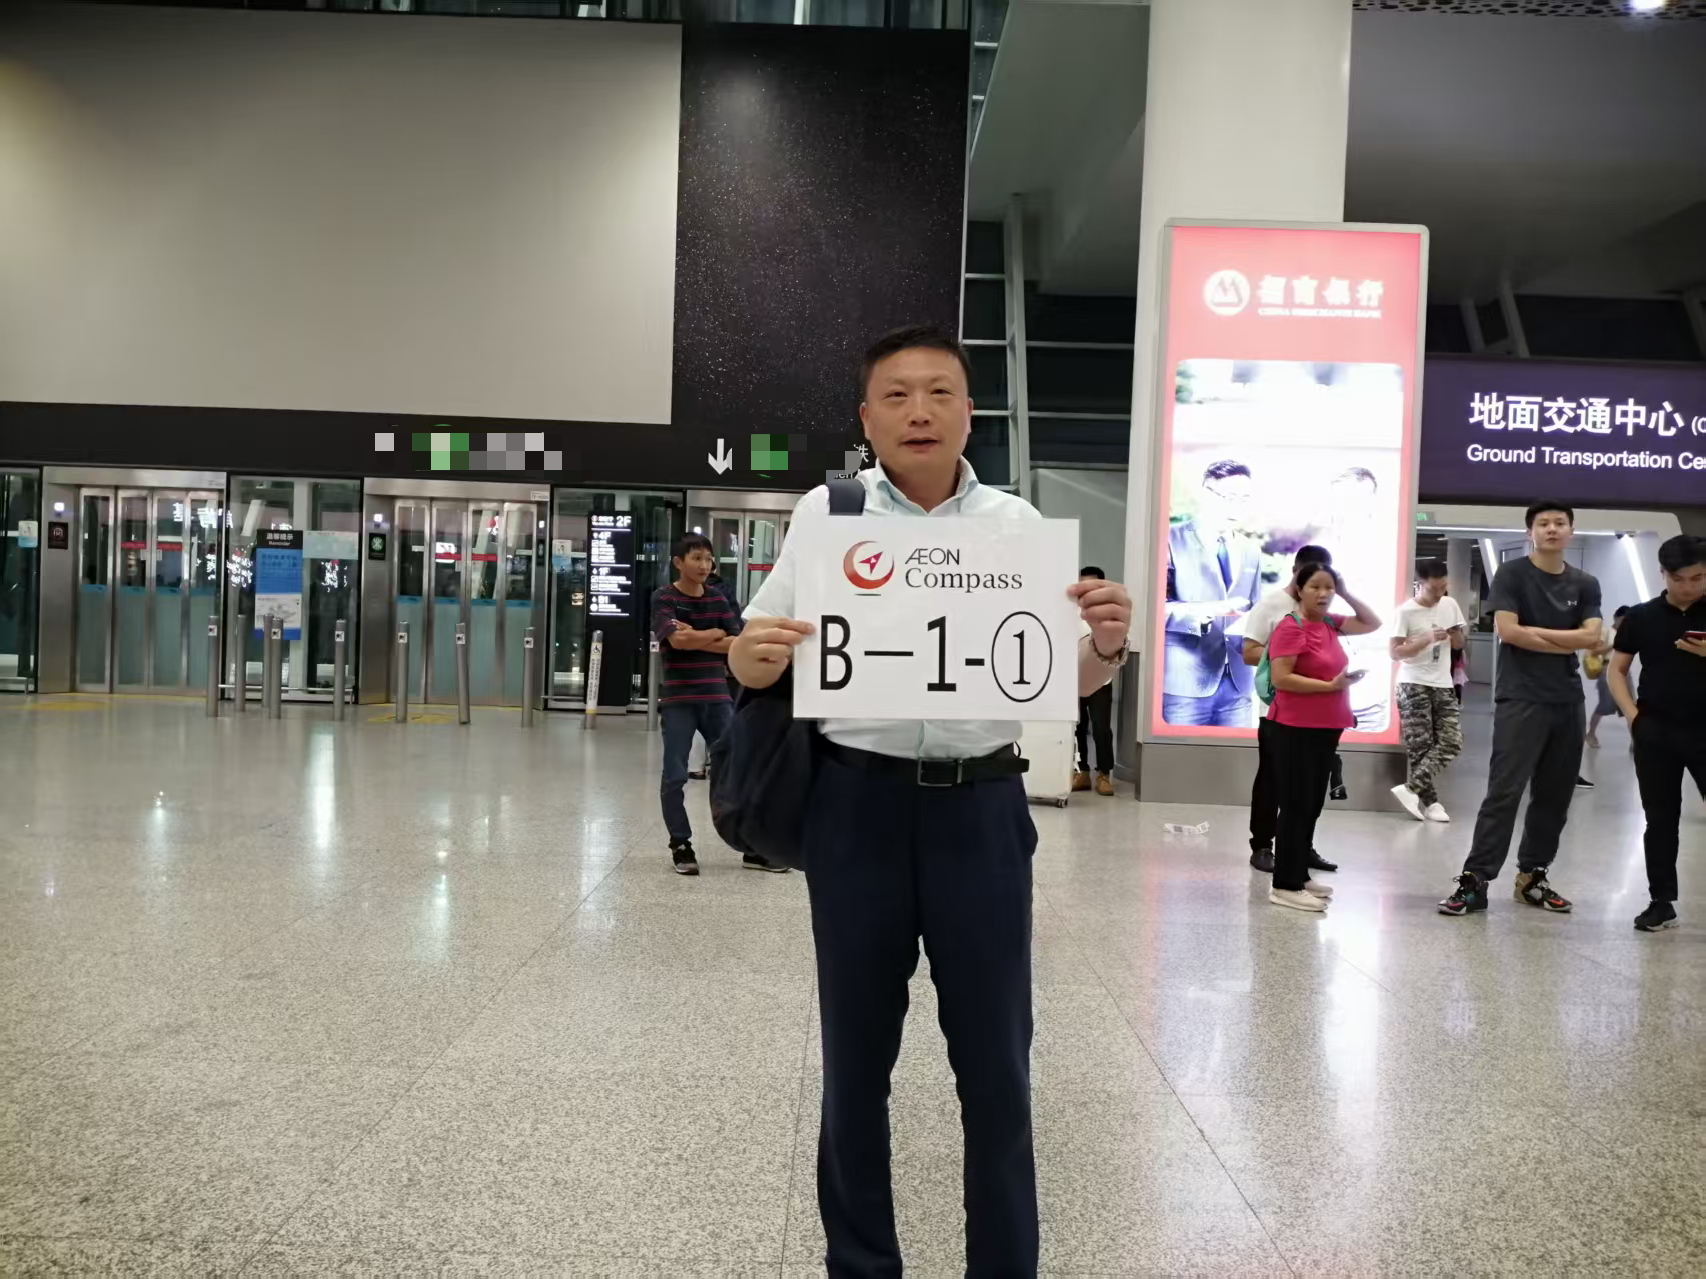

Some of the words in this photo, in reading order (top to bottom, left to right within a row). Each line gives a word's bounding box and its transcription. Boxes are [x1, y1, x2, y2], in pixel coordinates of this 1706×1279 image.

[1469, 392, 1684, 437] 地面交通中心
[1467, 444, 1536, 463] Ground
[1541, 446, 1673, 469] Transportation
[616, 515, 632, 527] 2F
[904, 568, 1023, 593] Compass
